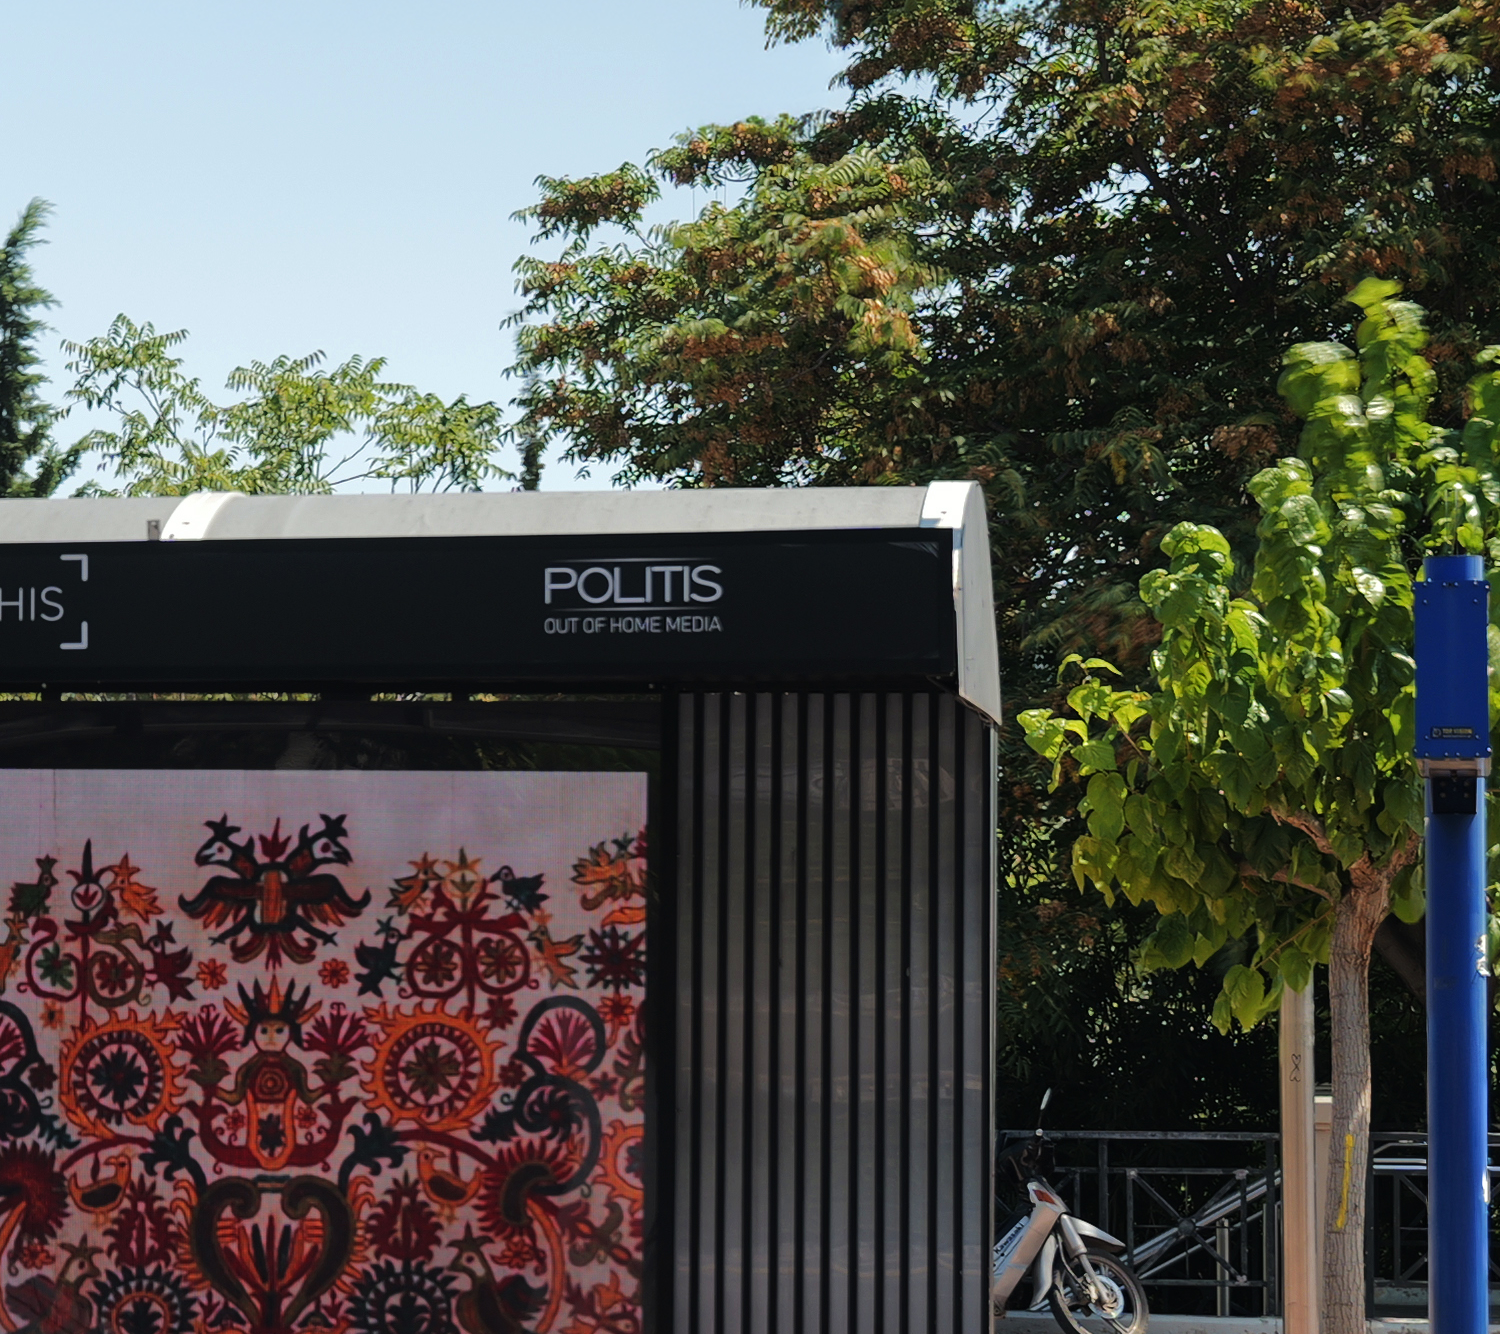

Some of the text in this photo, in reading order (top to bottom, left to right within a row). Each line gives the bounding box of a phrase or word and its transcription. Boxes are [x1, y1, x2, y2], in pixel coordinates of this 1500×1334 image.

[544, 564, 724, 605] POLITIS
[543, 615, 724, 634] OUT OF HOME MEDIA
